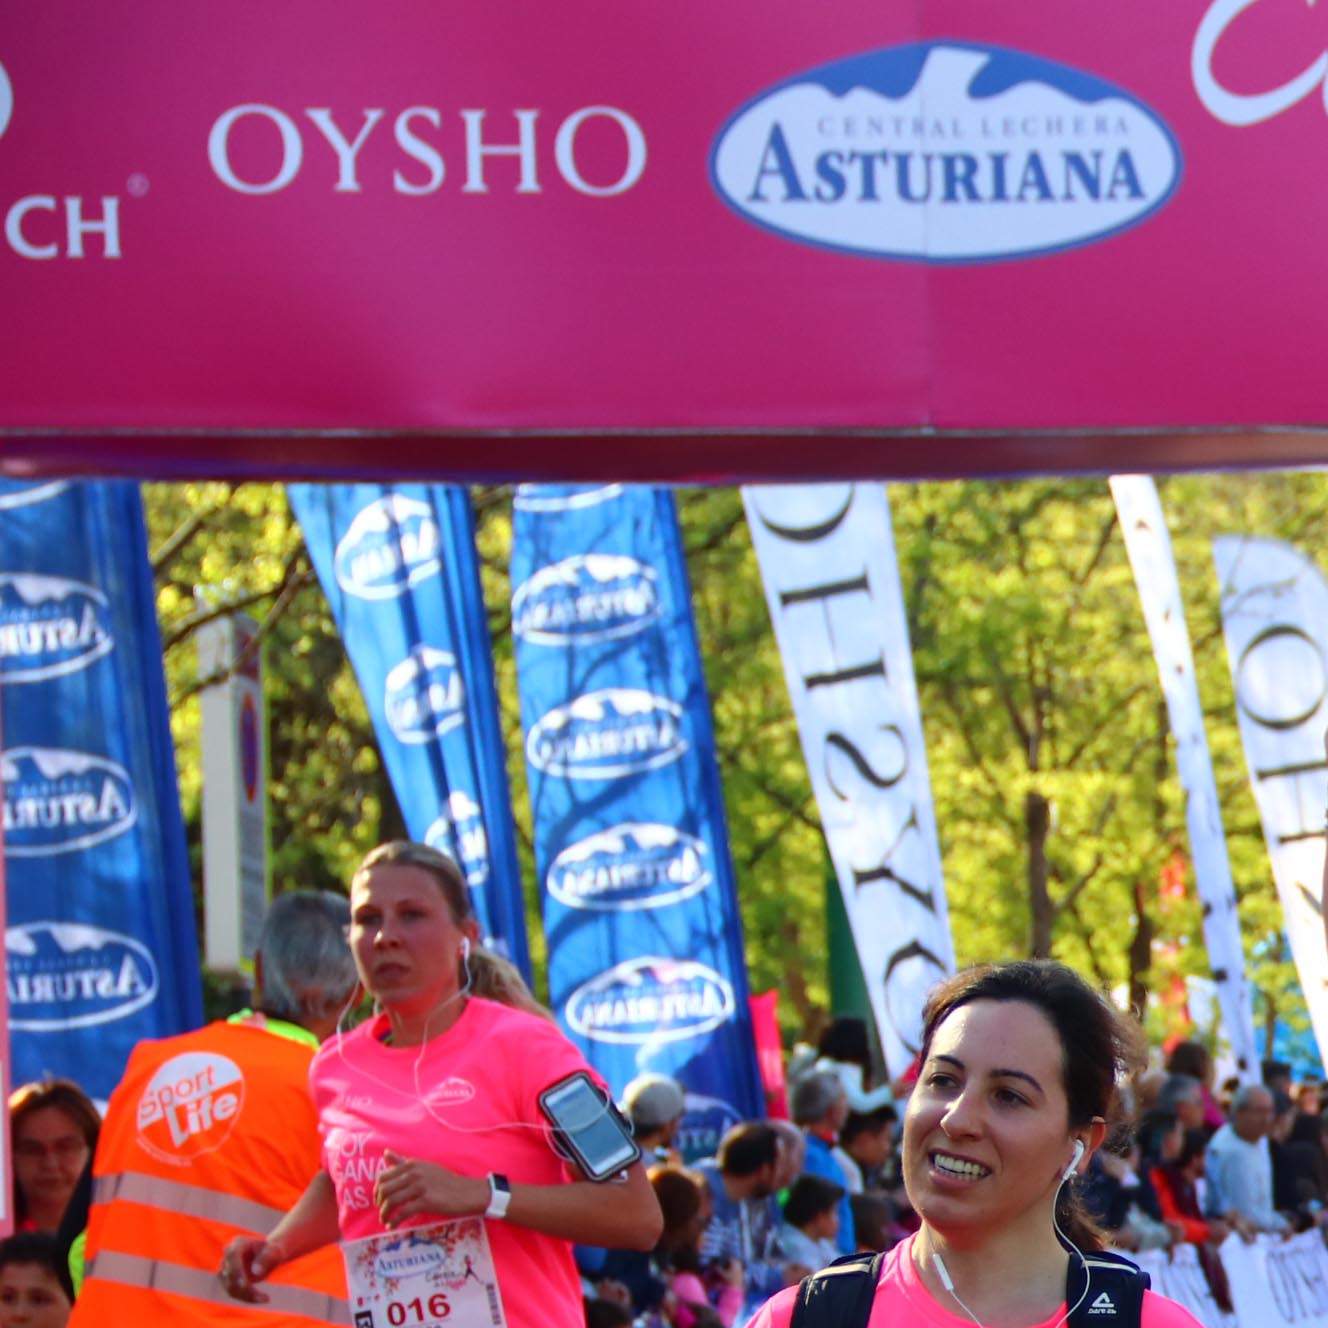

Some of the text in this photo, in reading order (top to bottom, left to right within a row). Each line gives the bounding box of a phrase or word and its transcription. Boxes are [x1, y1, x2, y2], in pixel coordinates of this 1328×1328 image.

[207, 103, 648, 197] OYSHO
[747, 121, 1147, 205] ASTURIANA
[166, 1093, 239, 1149] Life
[387, 1293, 451, 1327] 016
